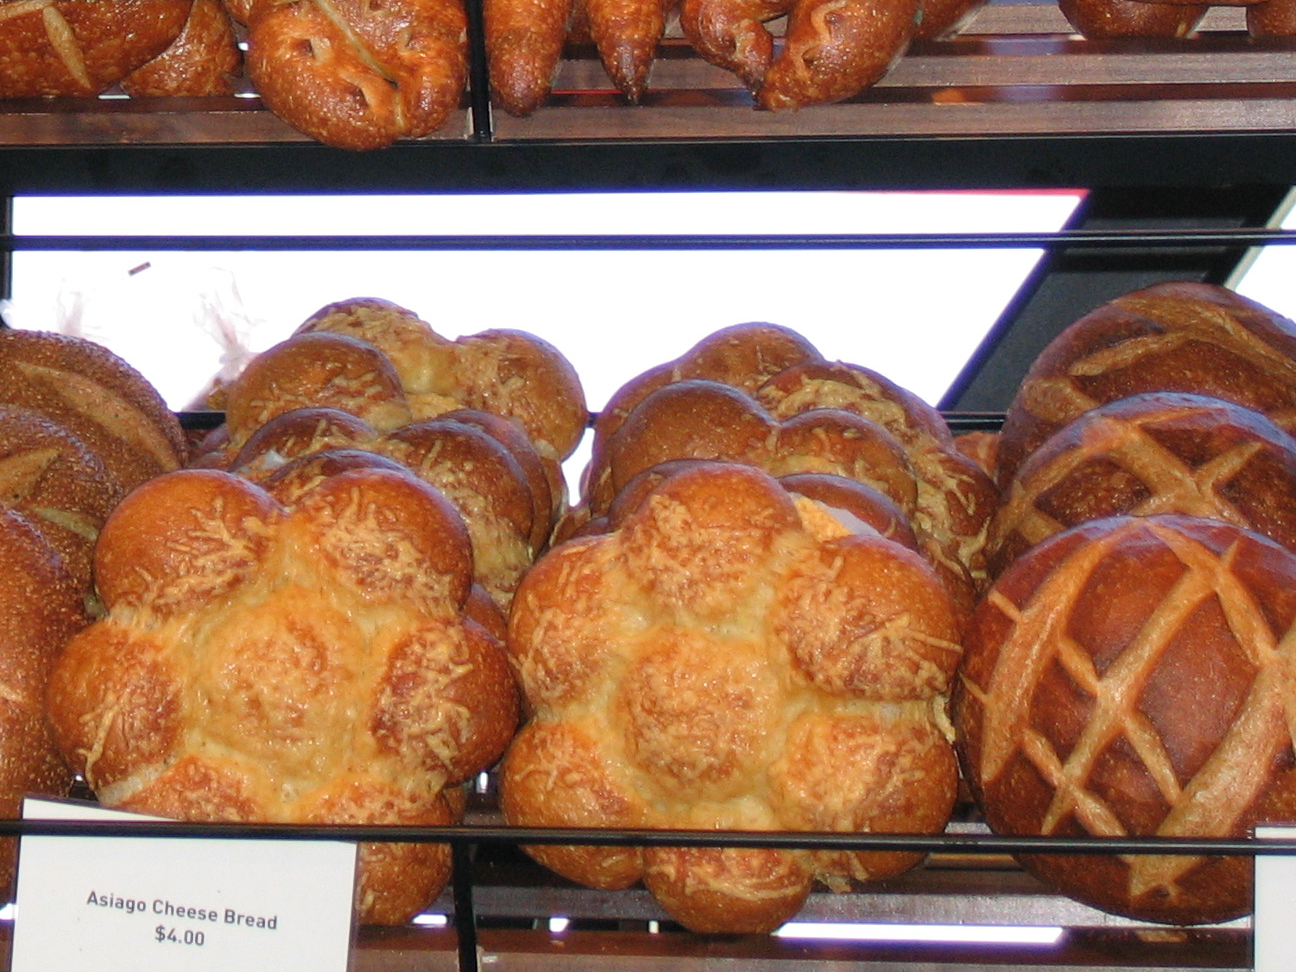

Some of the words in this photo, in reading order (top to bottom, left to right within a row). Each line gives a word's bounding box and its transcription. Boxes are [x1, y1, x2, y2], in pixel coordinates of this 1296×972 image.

[86, 891, 147, 914] Asiago
[153, 900, 218, 922] Cheese
[224, 909, 278, 930] Bread
[154, 925, 205, 946] $4.00
